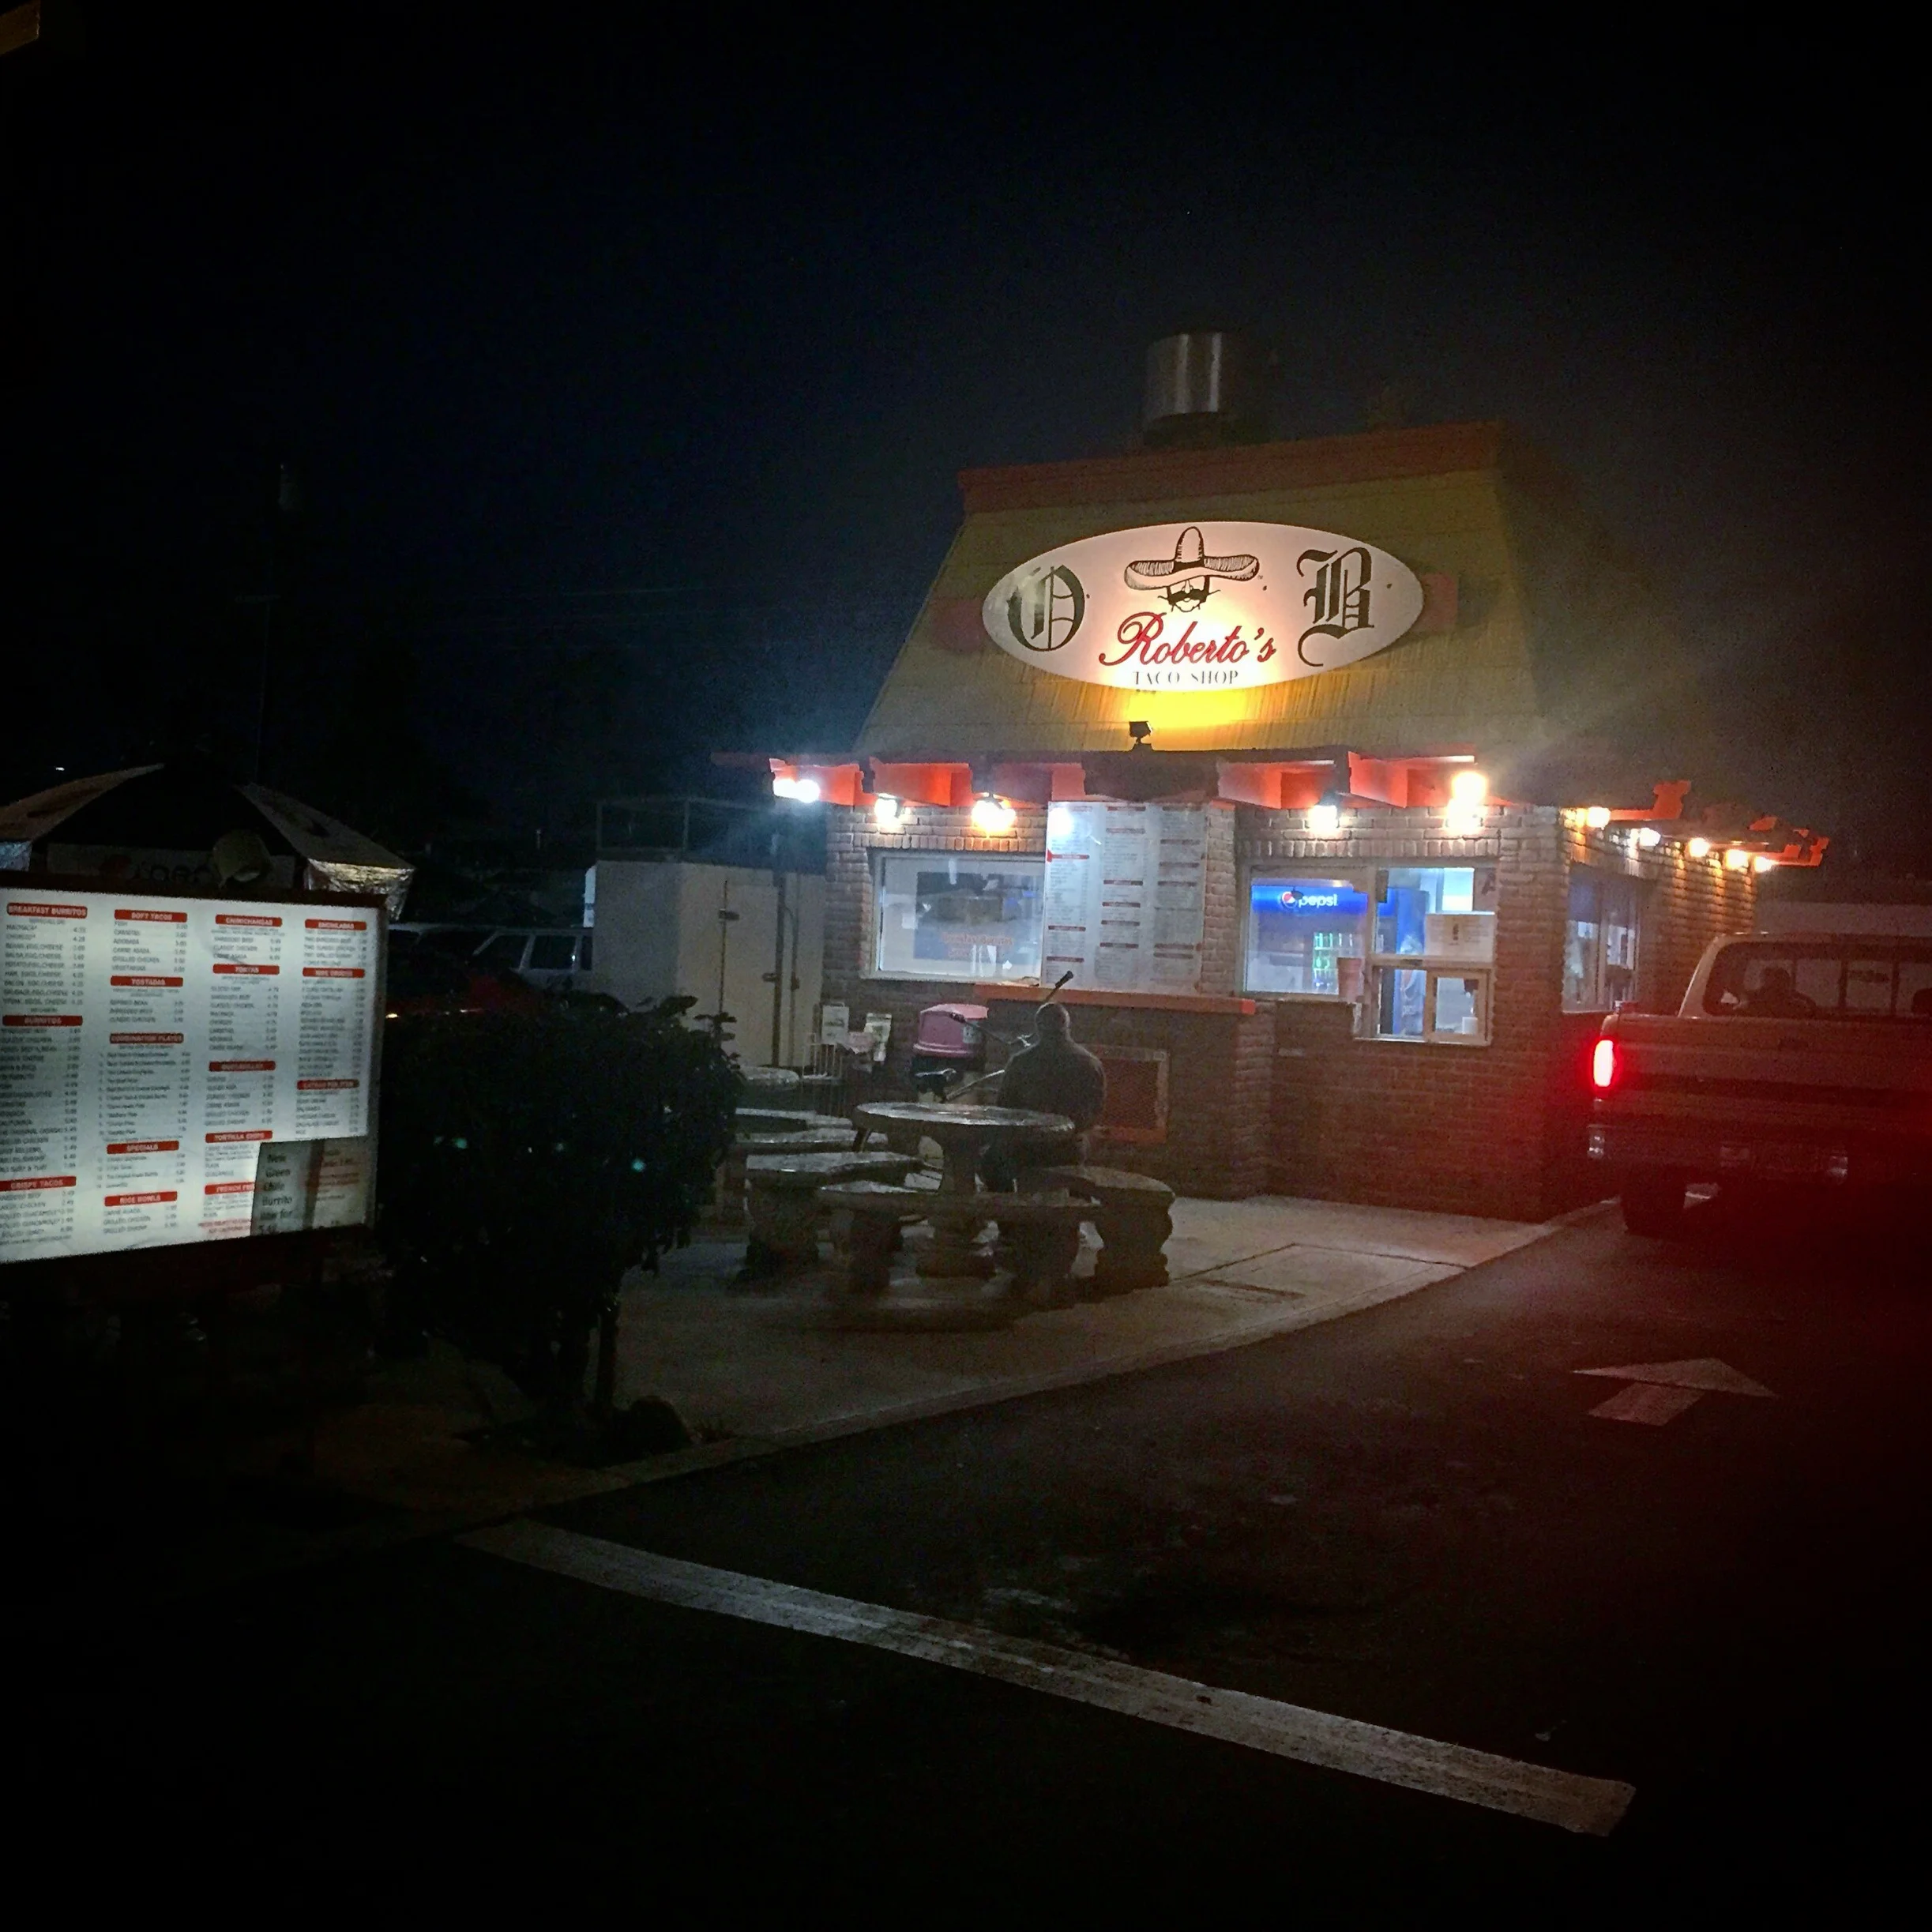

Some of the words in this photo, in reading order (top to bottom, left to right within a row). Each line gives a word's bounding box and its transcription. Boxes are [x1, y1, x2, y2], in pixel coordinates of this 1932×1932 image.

[1007, 565, 1085, 652] O
[1296, 547, 1375, 667] B
[1099, 611, 1277, 666] Roberto's
[1132, 671, 1181, 686] TACO
[1191, 670, 1239, 686] SHOP
[1298, 893, 1338, 908] pepsi
[8, 905, 50, 915] BREAKFAST
[51, 907, 86, 916] BURRITOS
[151, 912, 172, 921] TACOS
[126, 1144, 158, 1152] SPECIALS
[262, 1195, 292, 1206] Burrito
